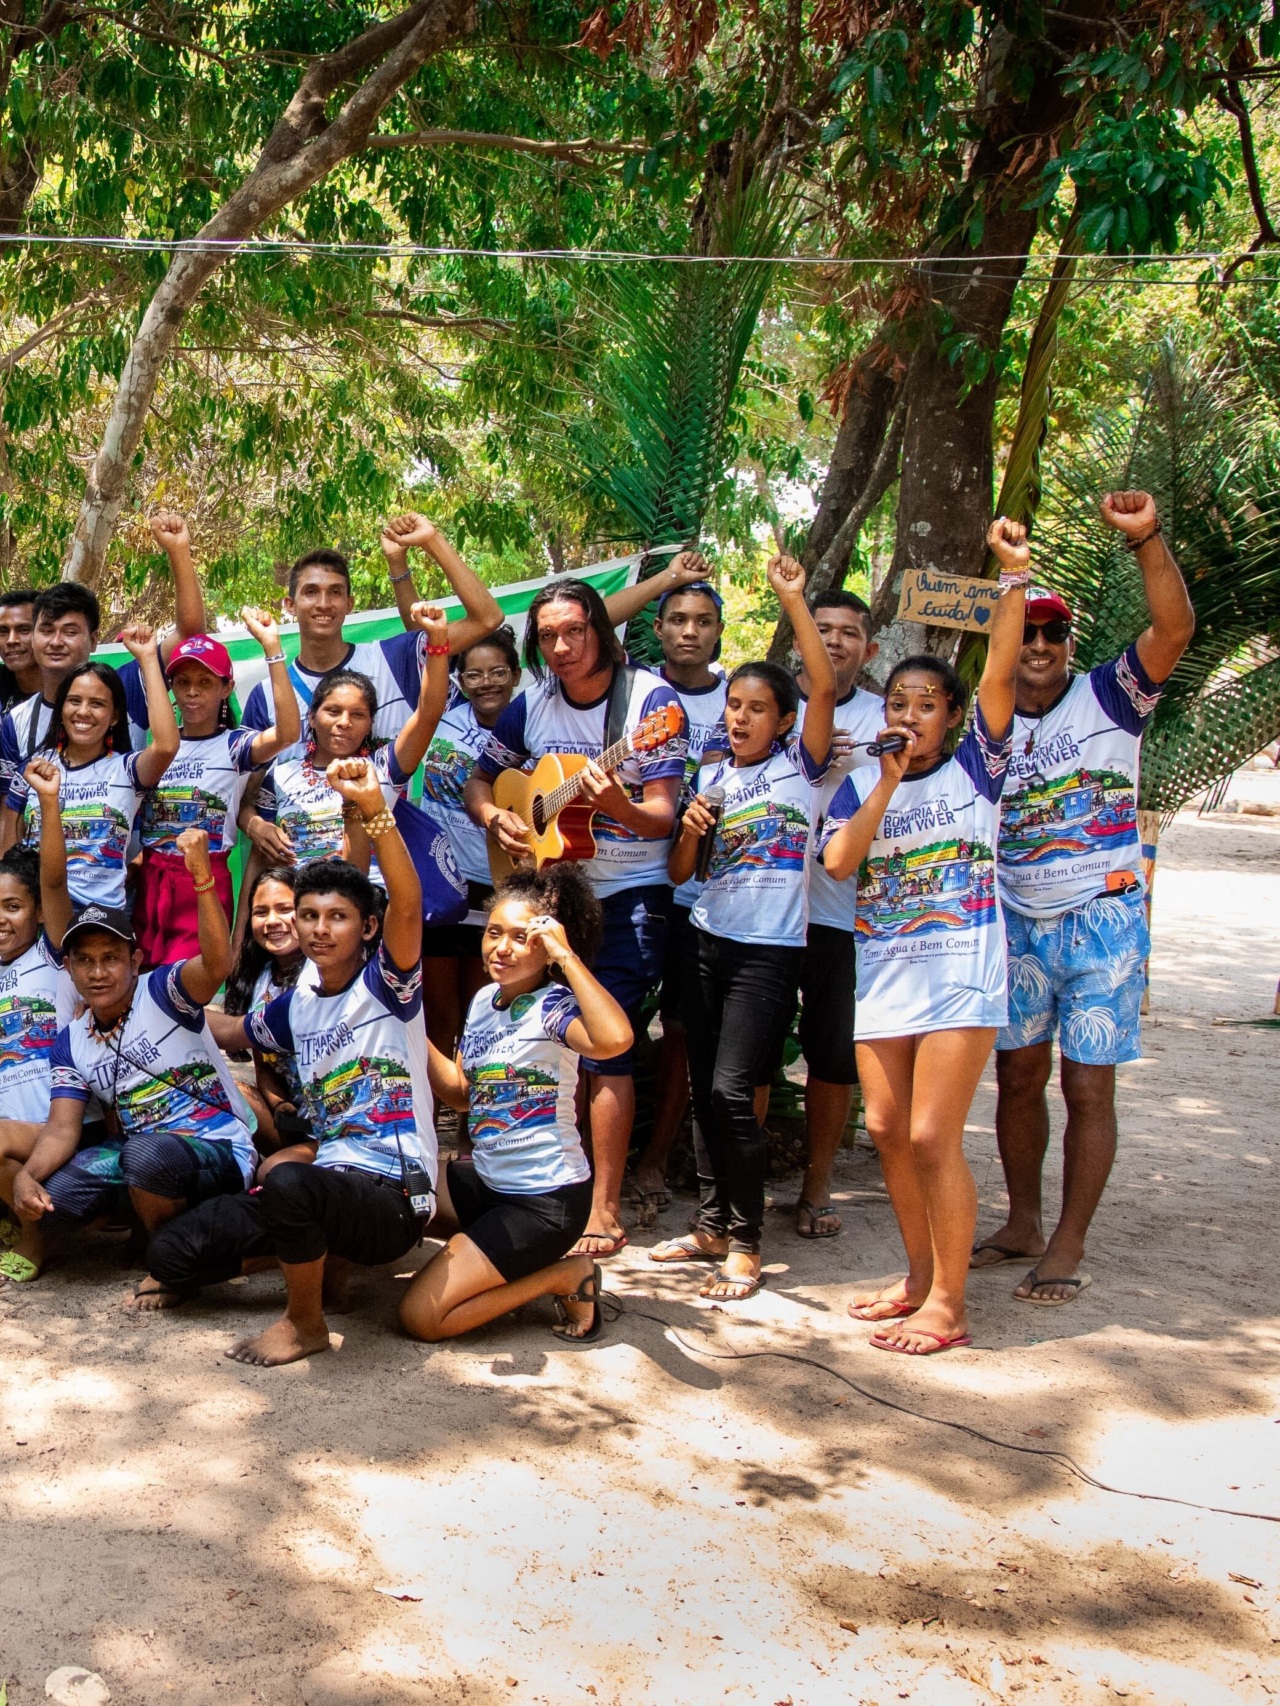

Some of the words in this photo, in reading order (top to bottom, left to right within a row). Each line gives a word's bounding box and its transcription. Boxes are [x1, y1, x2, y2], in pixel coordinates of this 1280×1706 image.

[1008, 762, 1039, 777] BEM
[883, 825, 912, 839] BEM
[916, 811, 956, 832] VIVER
[884, 805, 933, 828] ROMARIA
[610, 847, 648, 858] Comum
[1035, 870, 1040, 880] é
[1044, 868, 1068, 879] Bem
[1071, 860, 1111, 874] Comum
[752, 874, 787, 884] Comum
[911, 941, 917, 952] é
[920, 940, 942, 951] Bem
[300, 1038, 314, 1066] II
[93, 1061, 114, 1091] II
[140, 1037, 151, 1053] DO
[2, 1072, 18, 1083] Bem
